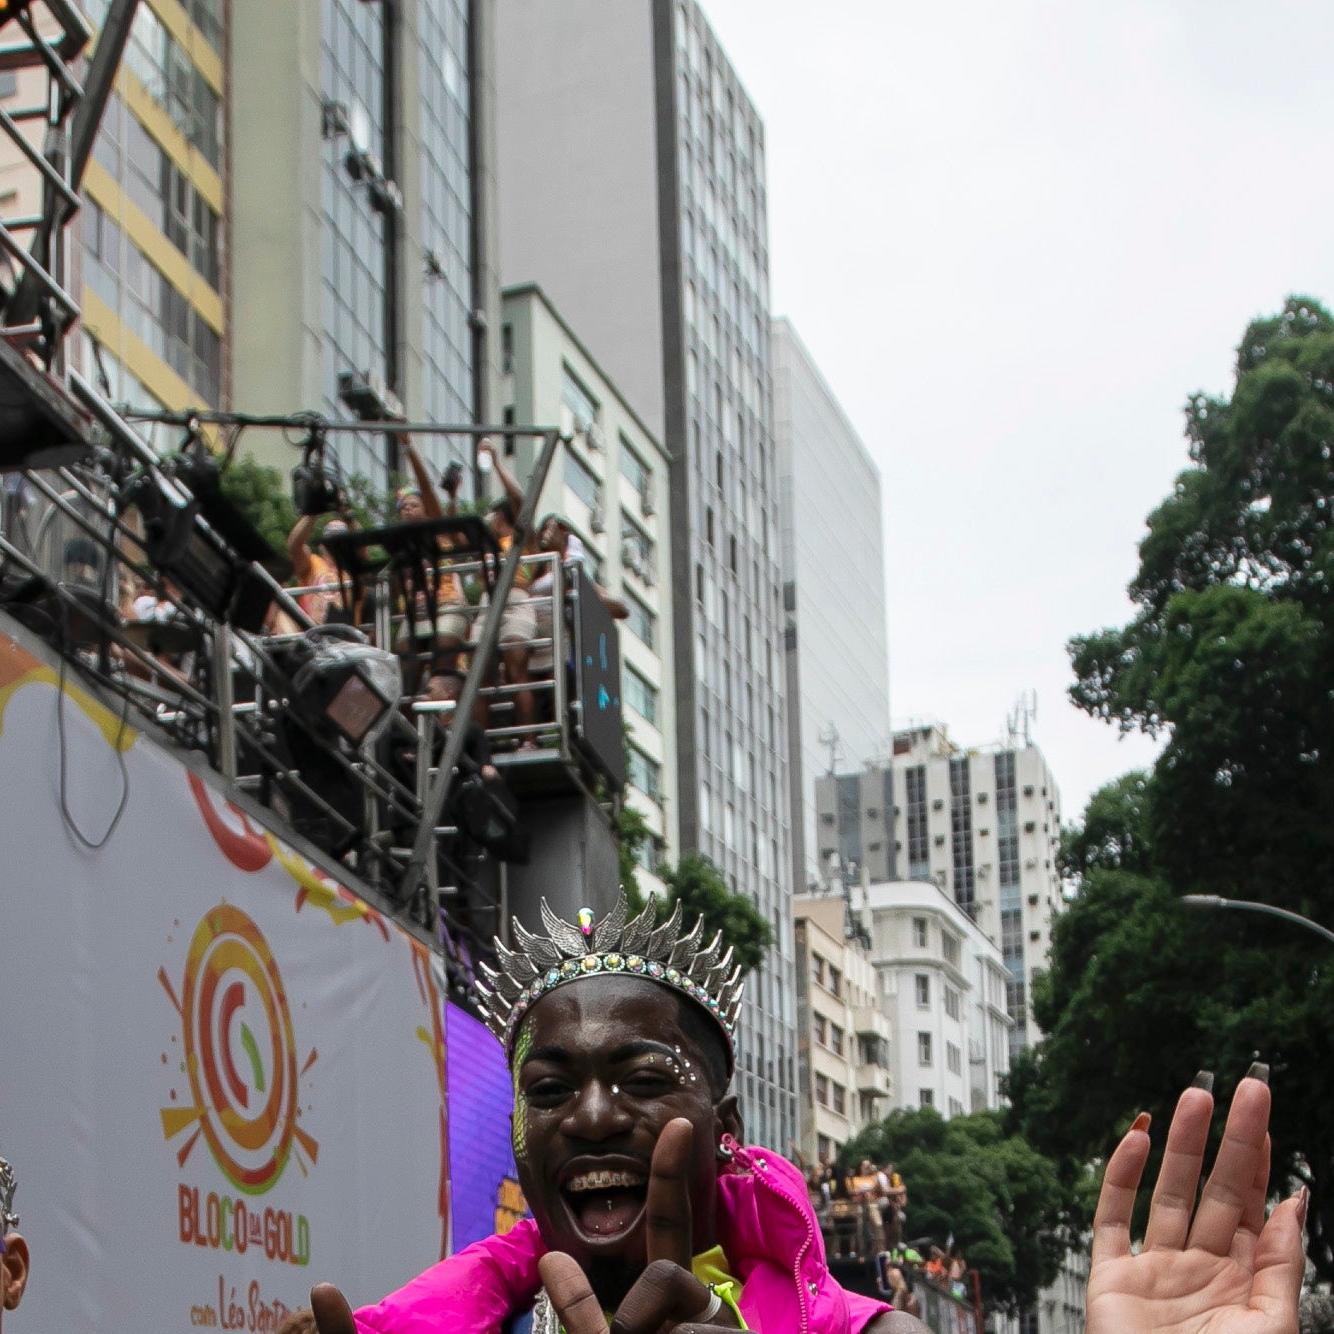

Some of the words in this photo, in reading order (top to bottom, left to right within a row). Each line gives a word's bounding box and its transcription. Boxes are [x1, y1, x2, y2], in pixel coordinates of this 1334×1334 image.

[178, 1183, 247, 1254] BLOCO
[249, 1210, 262, 1238] DA
[264, 1206, 311, 1267] GOLD
[190, 1303, 217, 1328] com
[219, 1273, 246, 1331] Léo
